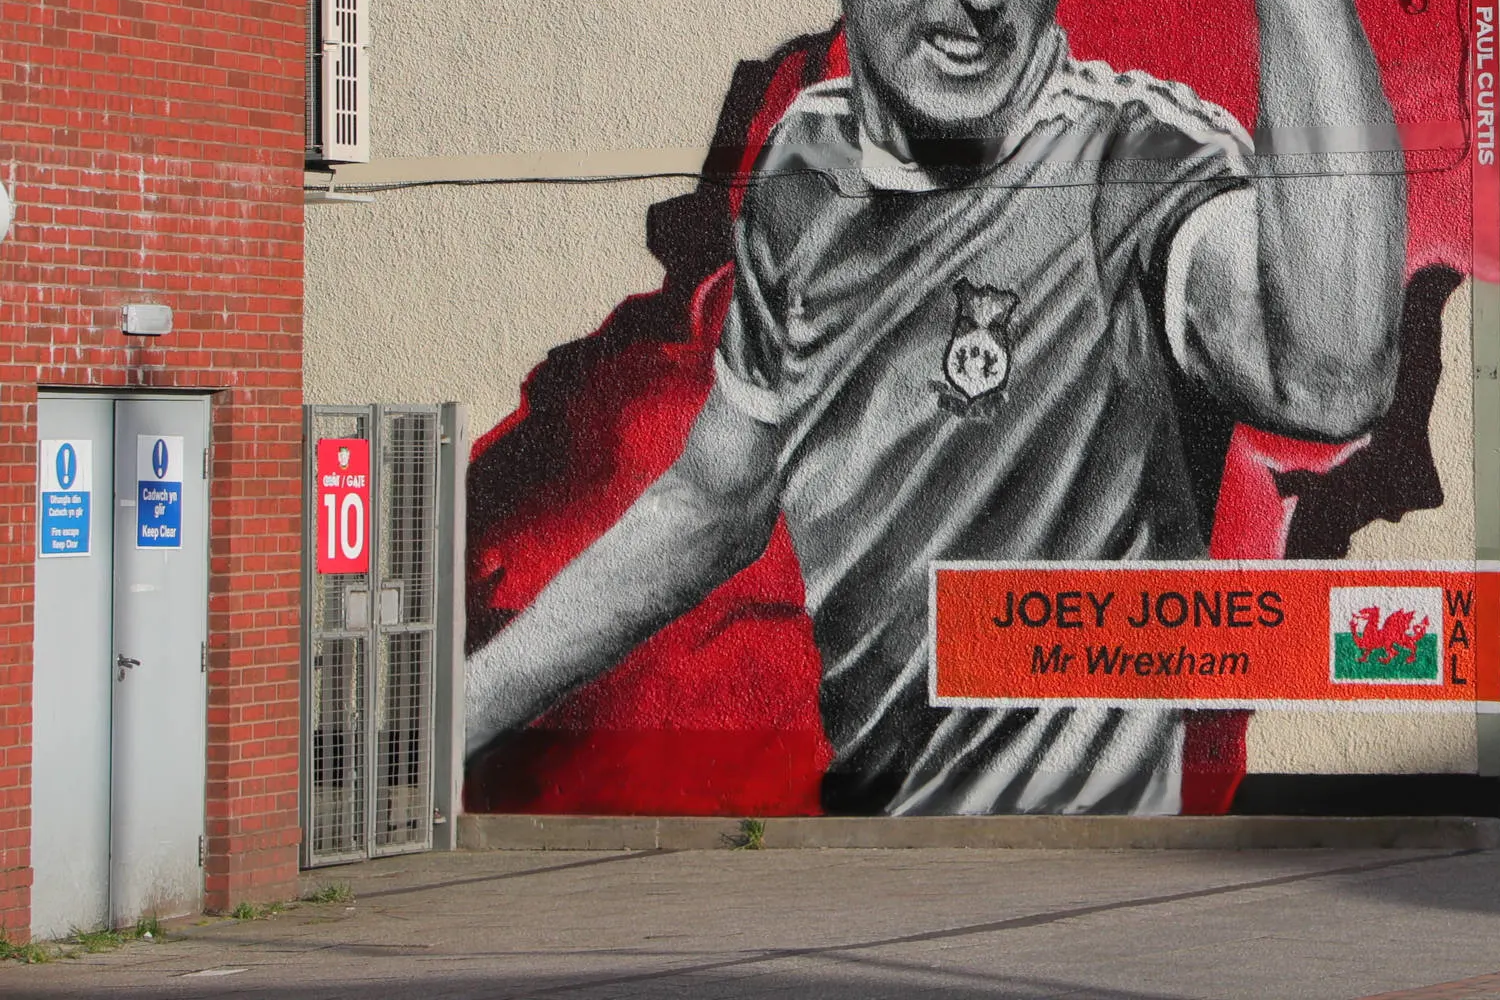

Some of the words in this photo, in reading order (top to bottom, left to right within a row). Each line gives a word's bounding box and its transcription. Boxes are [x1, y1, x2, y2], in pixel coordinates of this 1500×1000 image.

[1476, 7, 1493, 69] PAUL
[1476, 72, 1495, 166] CURTIS
[143, 488, 168, 501] Cadwch
[168, 492, 177, 504] yn
[346, 475, 365, 488] GATE
[142, 525, 159, 540] Keep
[159, 525, 176, 538] Clear
[323, 492, 364, 560] 10
[993, 591, 1116, 628] JOEY
[1128, 591, 1285, 628] JONES
[1446, 589, 1473, 685] WAL
[1031, 645, 1075, 676] Mr
[1086, 645, 1250, 677] Wrexham
